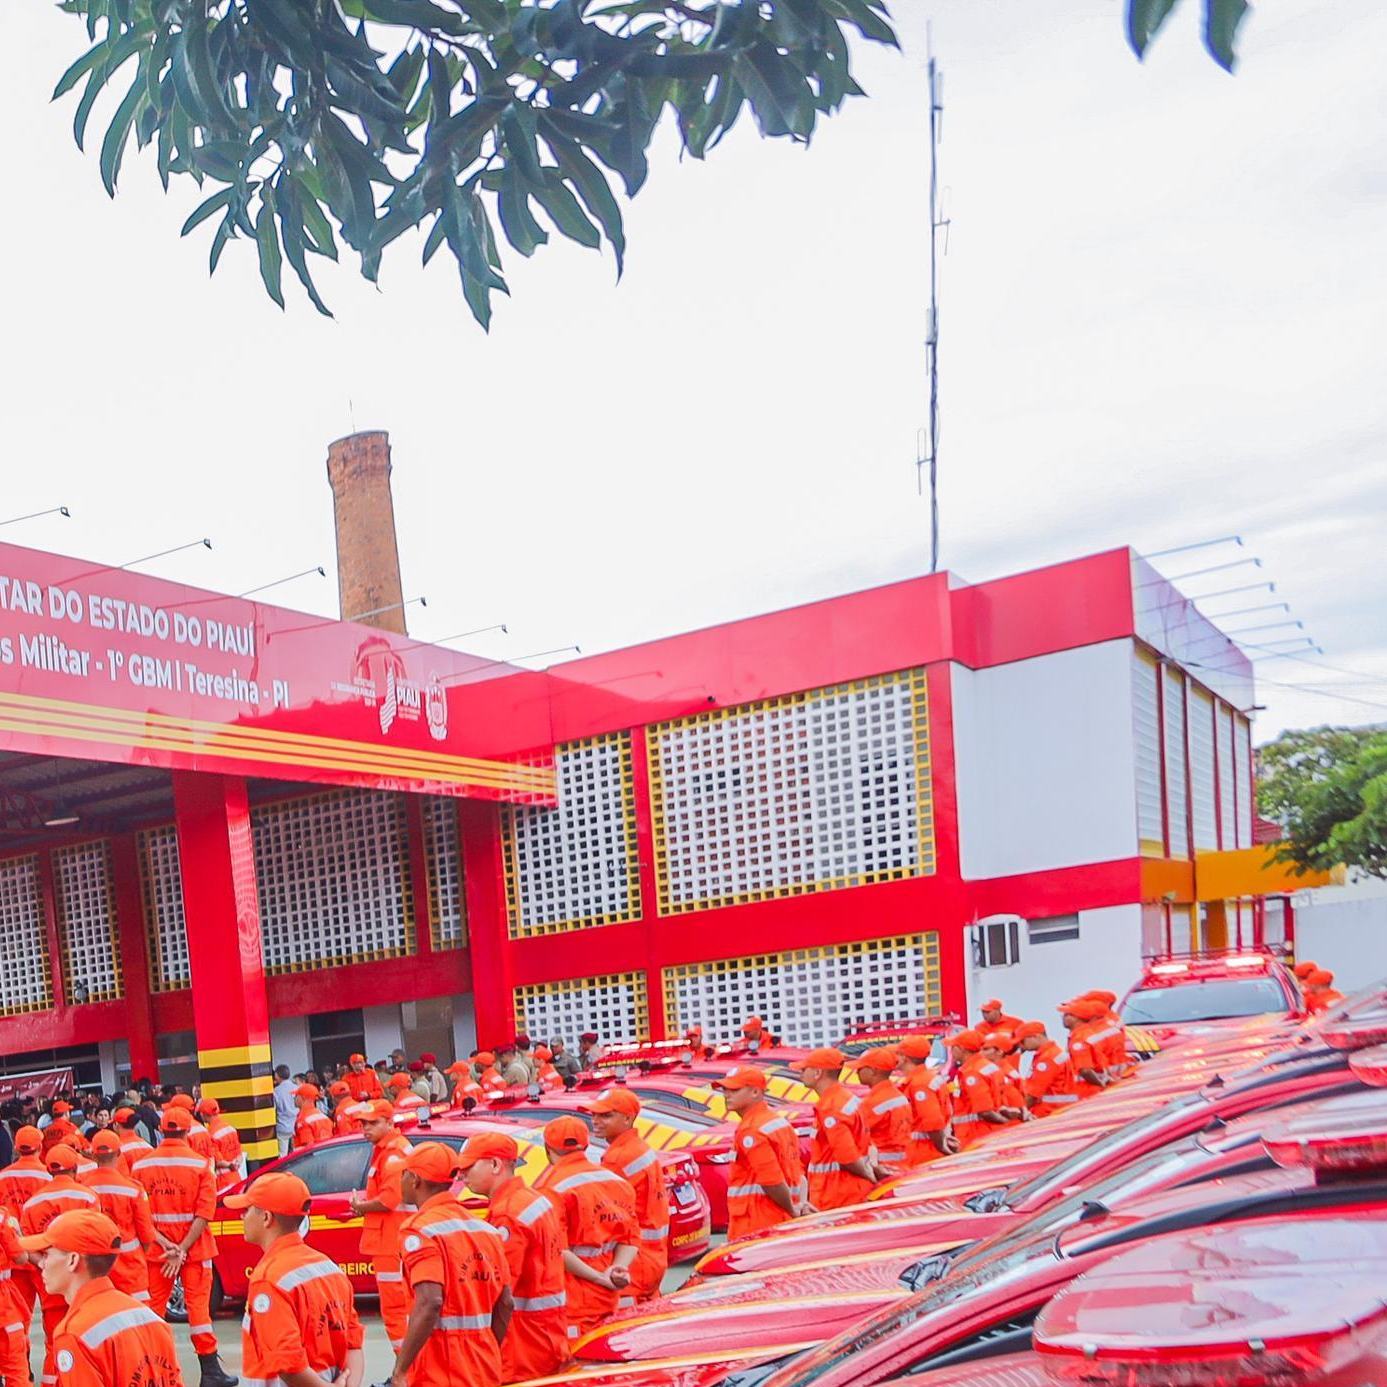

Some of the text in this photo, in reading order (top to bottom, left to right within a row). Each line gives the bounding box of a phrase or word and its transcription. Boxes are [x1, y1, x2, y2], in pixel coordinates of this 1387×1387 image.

[48, 589, 84, 624] DO
[89, 594, 170, 639] ESTADO
[174, 611, 203, 645] DO
[206, 620, 256, 658] PIAUÍ
[19, 634, 90, 677] Militar
[128, 652, 172, 691] GBM
[184, 662, 259, 706] Teresina
[272, 680, 290, 709] PI
